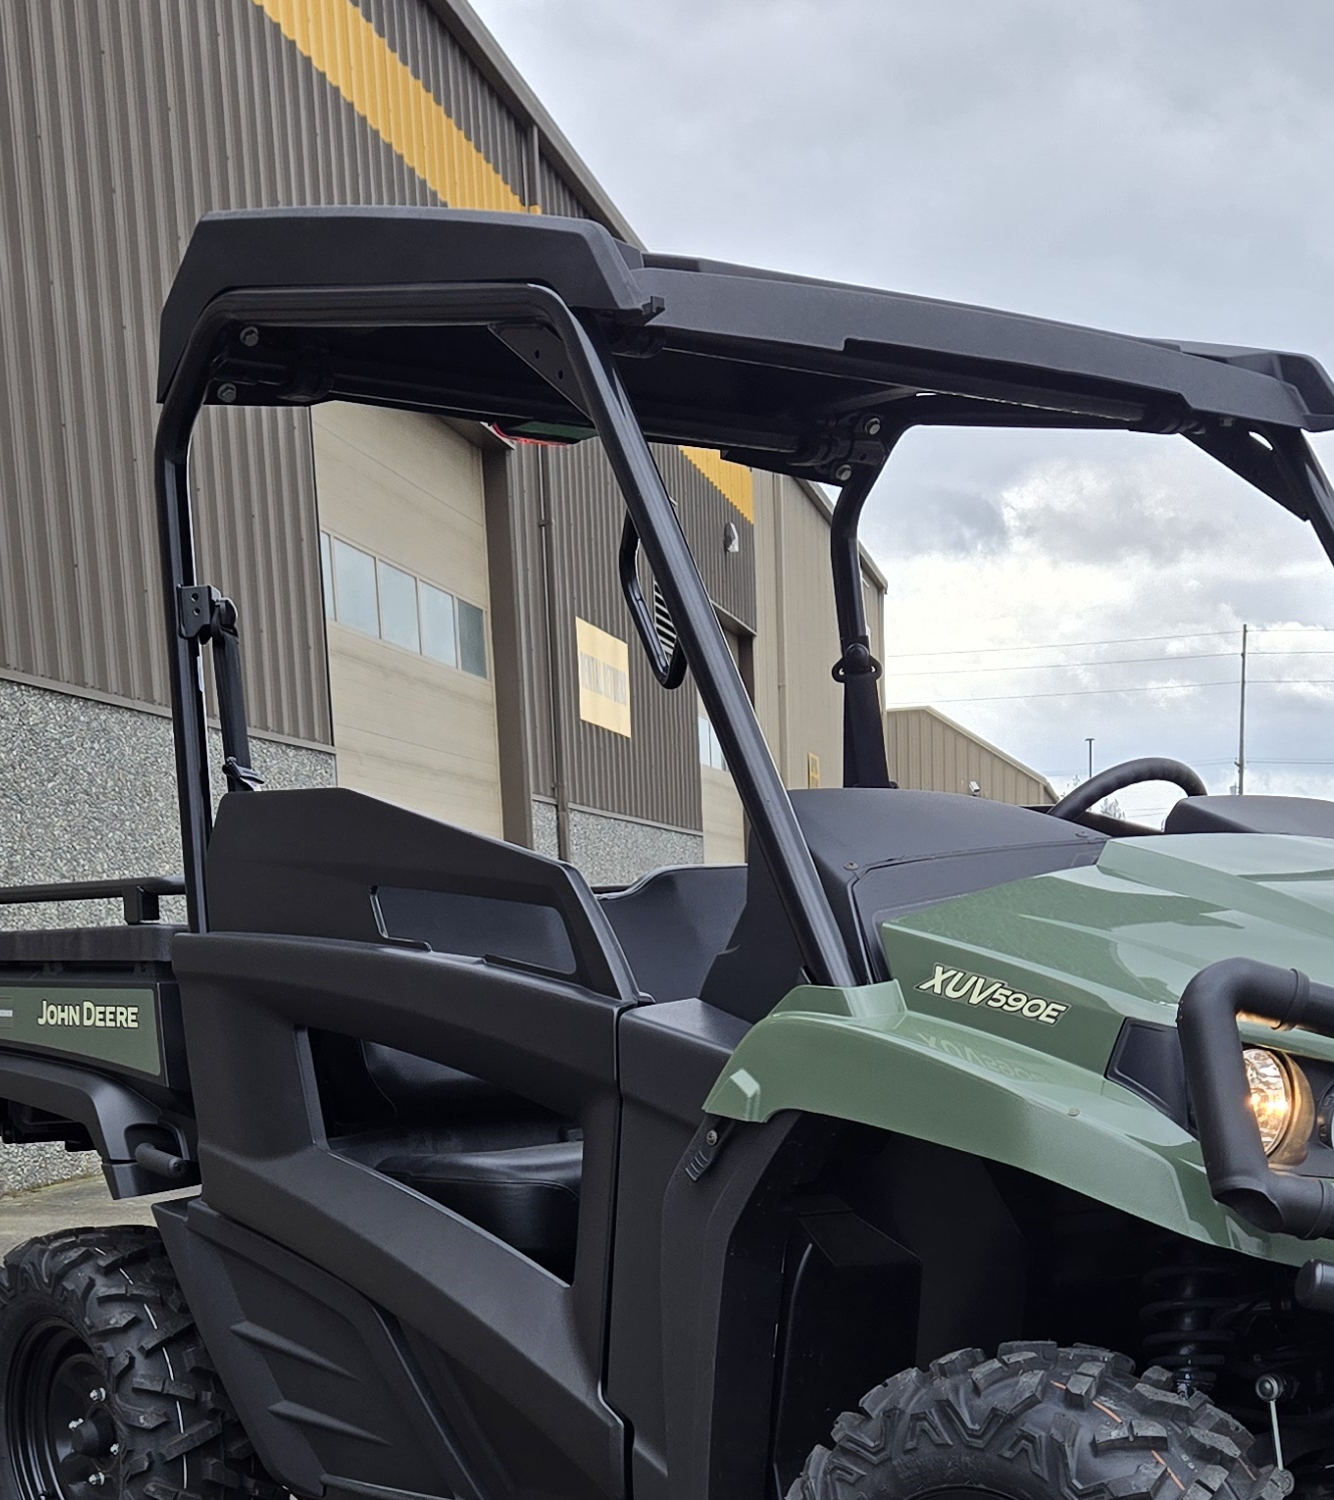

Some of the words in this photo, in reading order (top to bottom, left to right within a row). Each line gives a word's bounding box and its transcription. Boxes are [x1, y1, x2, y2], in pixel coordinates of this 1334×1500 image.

[37, 1000, 80, 1027] JOHN
[83, 1000, 139, 1028] DEERE
[917, 964, 1068, 1025] XUV590E
